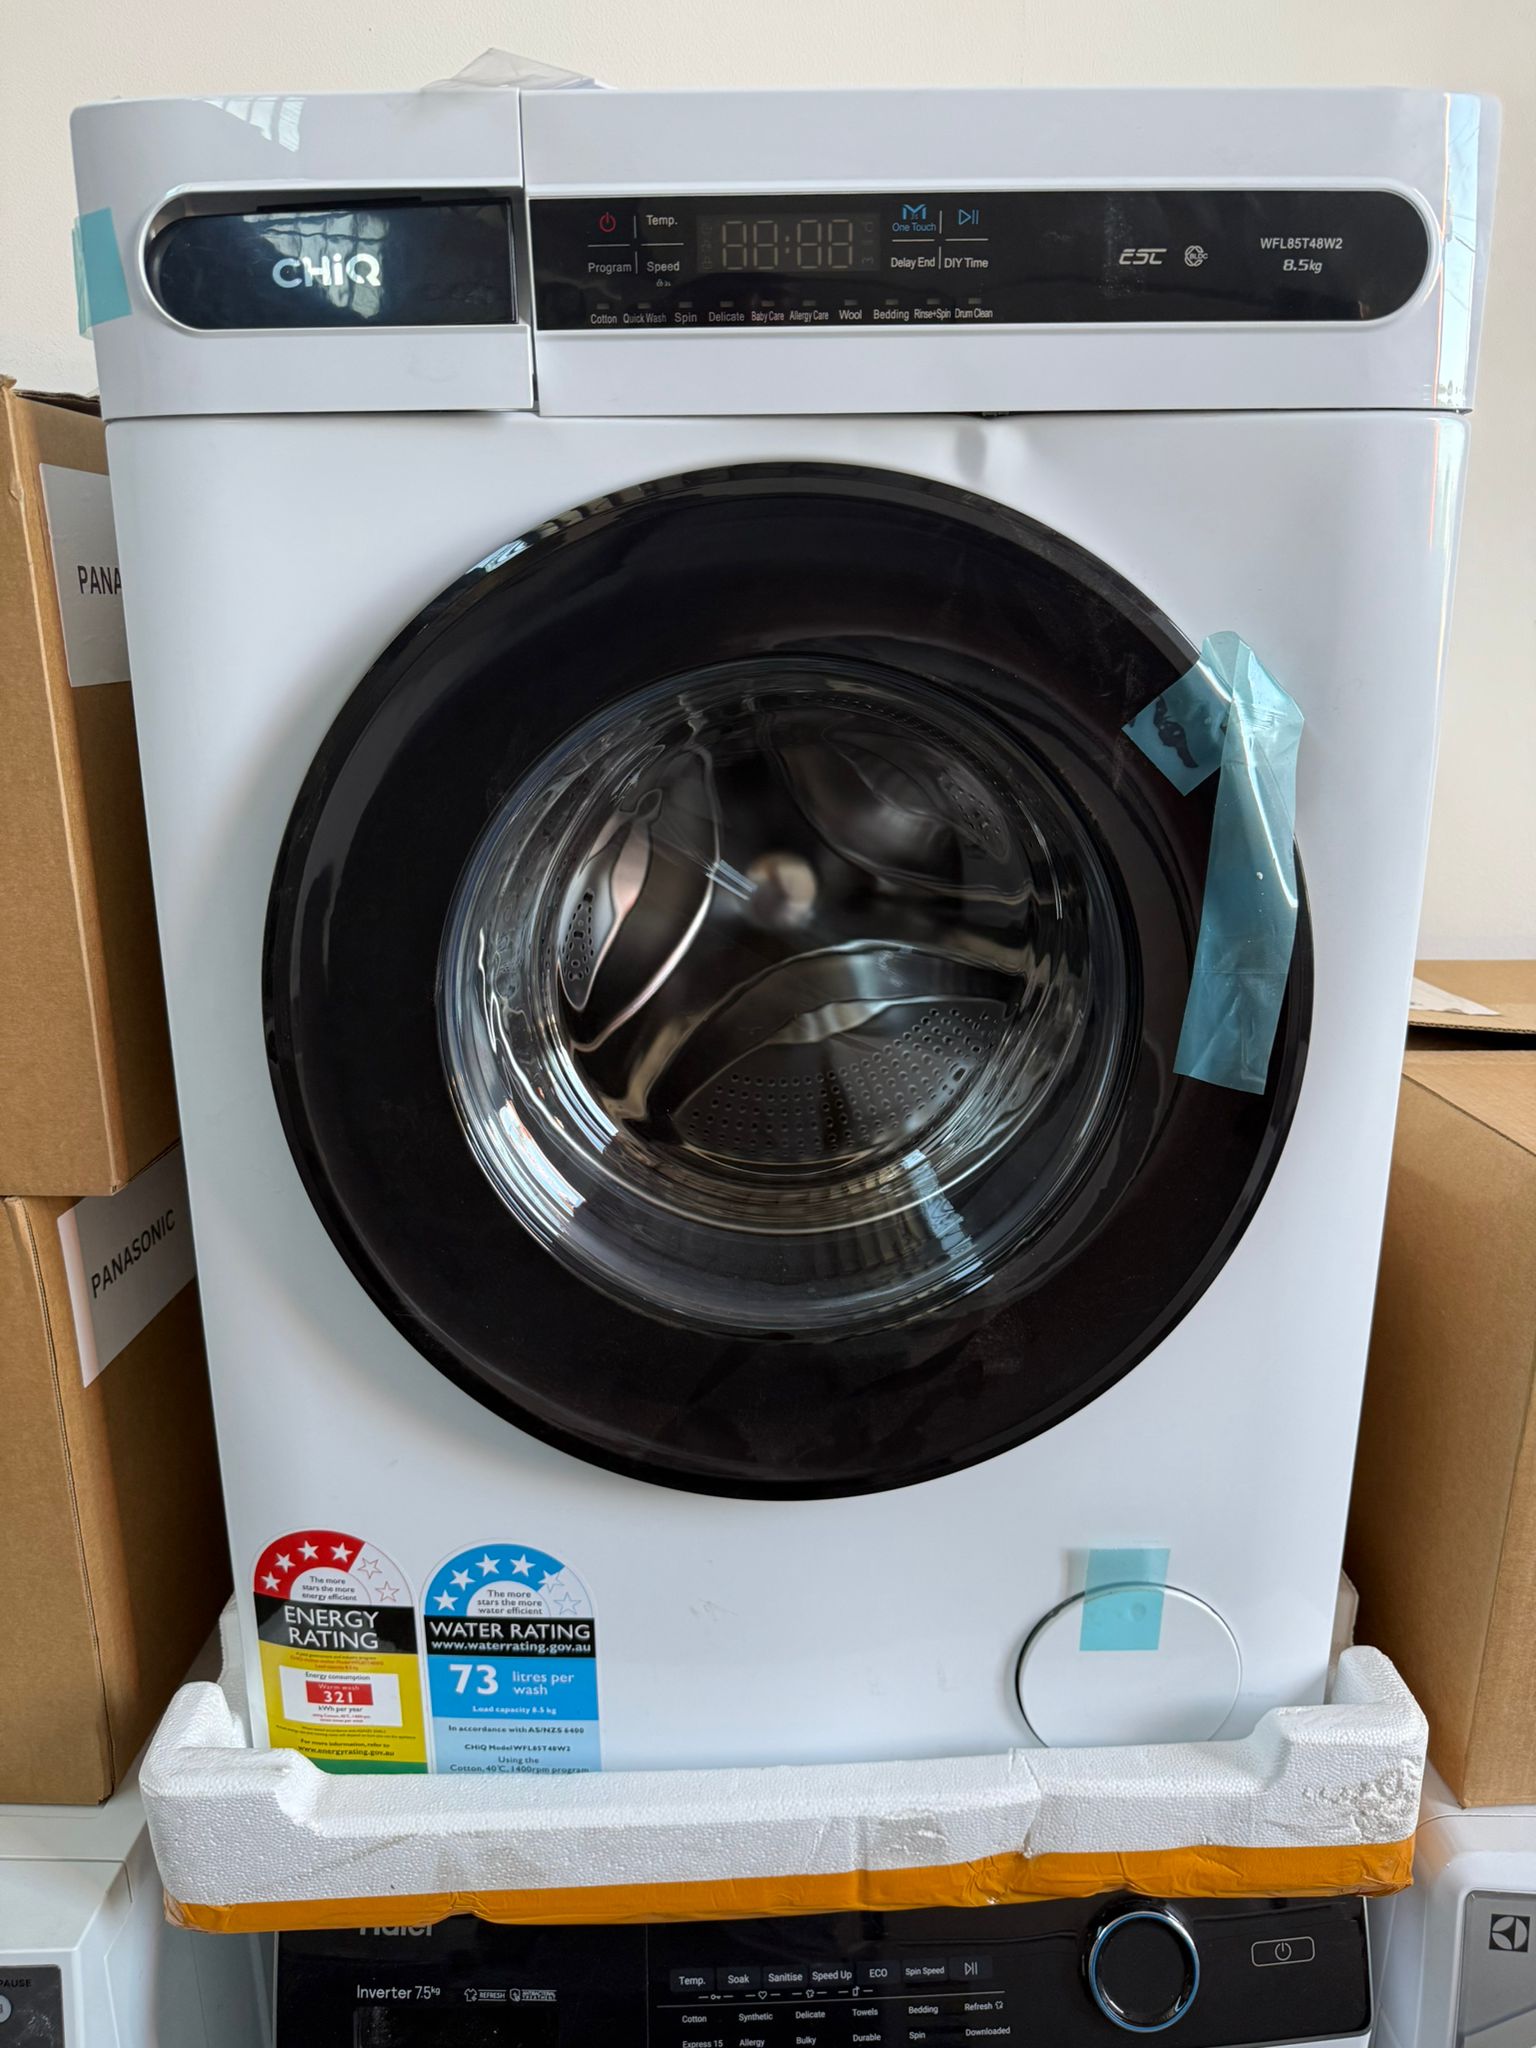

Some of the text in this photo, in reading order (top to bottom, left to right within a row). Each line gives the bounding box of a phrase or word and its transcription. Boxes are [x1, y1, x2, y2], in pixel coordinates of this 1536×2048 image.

[646, 214, 678, 228] Temp.
[892, 222, 937, 232] One Touch
[1259, 237, 1344, 250] WFL85T48W2
[647, 261, 681, 274] Speed
[890, 256, 936, 270] Delay End
[944, 257, 989, 268] DIY Time
[1282, 258, 1323, 274] 8.5kg
[272, 253, 381, 288] CHiQ
[588, 262, 632, 275] Program
[590, 313, 617, 324] Cotton
[623, 312, 667, 324] Quick Wash
[674, 312, 697, 325] Spin
[708, 311, 745, 322] Delicate
[751, 311, 785, 323] Baby Care
[789, 310, 829, 323] Allergy Care
[838, 310, 863, 320] Wool
[873, 309, 910, 321] Bedding
[913, 309, 951, 320] Rinse+Spin
[954, 308, 993, 319] Drum Clean
[91, 1209, 176, 1299] PANASONIC
[310, 1575, 346, 1585] The more
[302, 1592, 357, 1601] energy efficient
[488, 1590, 506, 1598] The
[284, 1605, 380, 1628] ENERGY
[506, 1607, 543, 1615] efficient
[430, 1621, 591, 1640] WATER RATING
[288, 1627, 378, 1650] RATING
[431, 1640, 592, 1655] www.waterrating.gov.au
[305, 1671, 371, 1681] Energy consumption
[449, 1663, 500, 1695] 73
[512, 1671, 575, 1686] litres per
[513, 1684, 548, 1695] wash
[323, 1690, 353, 1704] 321
[318, 1705, 363, 1714] kWh per year
[472, 1705, 557, 1715] Load capacity 8.5 kg
[498, 1756, 523, 1765] Using
[768, 1972, 803, 1982] Sanitise
[812, 1970, 853, 1981] Speed Up
[869, 1968, 888, 1978] ECO
[905, 1966, 945, 1977] Spin Speed
[678, 1976, 707, 1987] Temp.
[727, 1974, 750, 1984] Soak
[357, 1984, 412, 1999] Inverter
[852, 2008, 878, 2016] Towels
[908, 2005, 939, 2015] Bedding
[964, 2002, 993, 2011] Refresh
[682, 2015, 707, 2023] Cotton
[739, 2012, 773, 2022] Synthetic
[795, 2010, 826, 2019] Delicate
[853, 2033, 881, 2042] Durable
[909, 2031, 926, 2041] Spin
[965, 2027, 1011, 2037] Downloaded
[713, 2040, 723, 2048] 15
[739, 2038, 765, 2048] Allergy
[796, 2036, 816, 2046] Bulky
